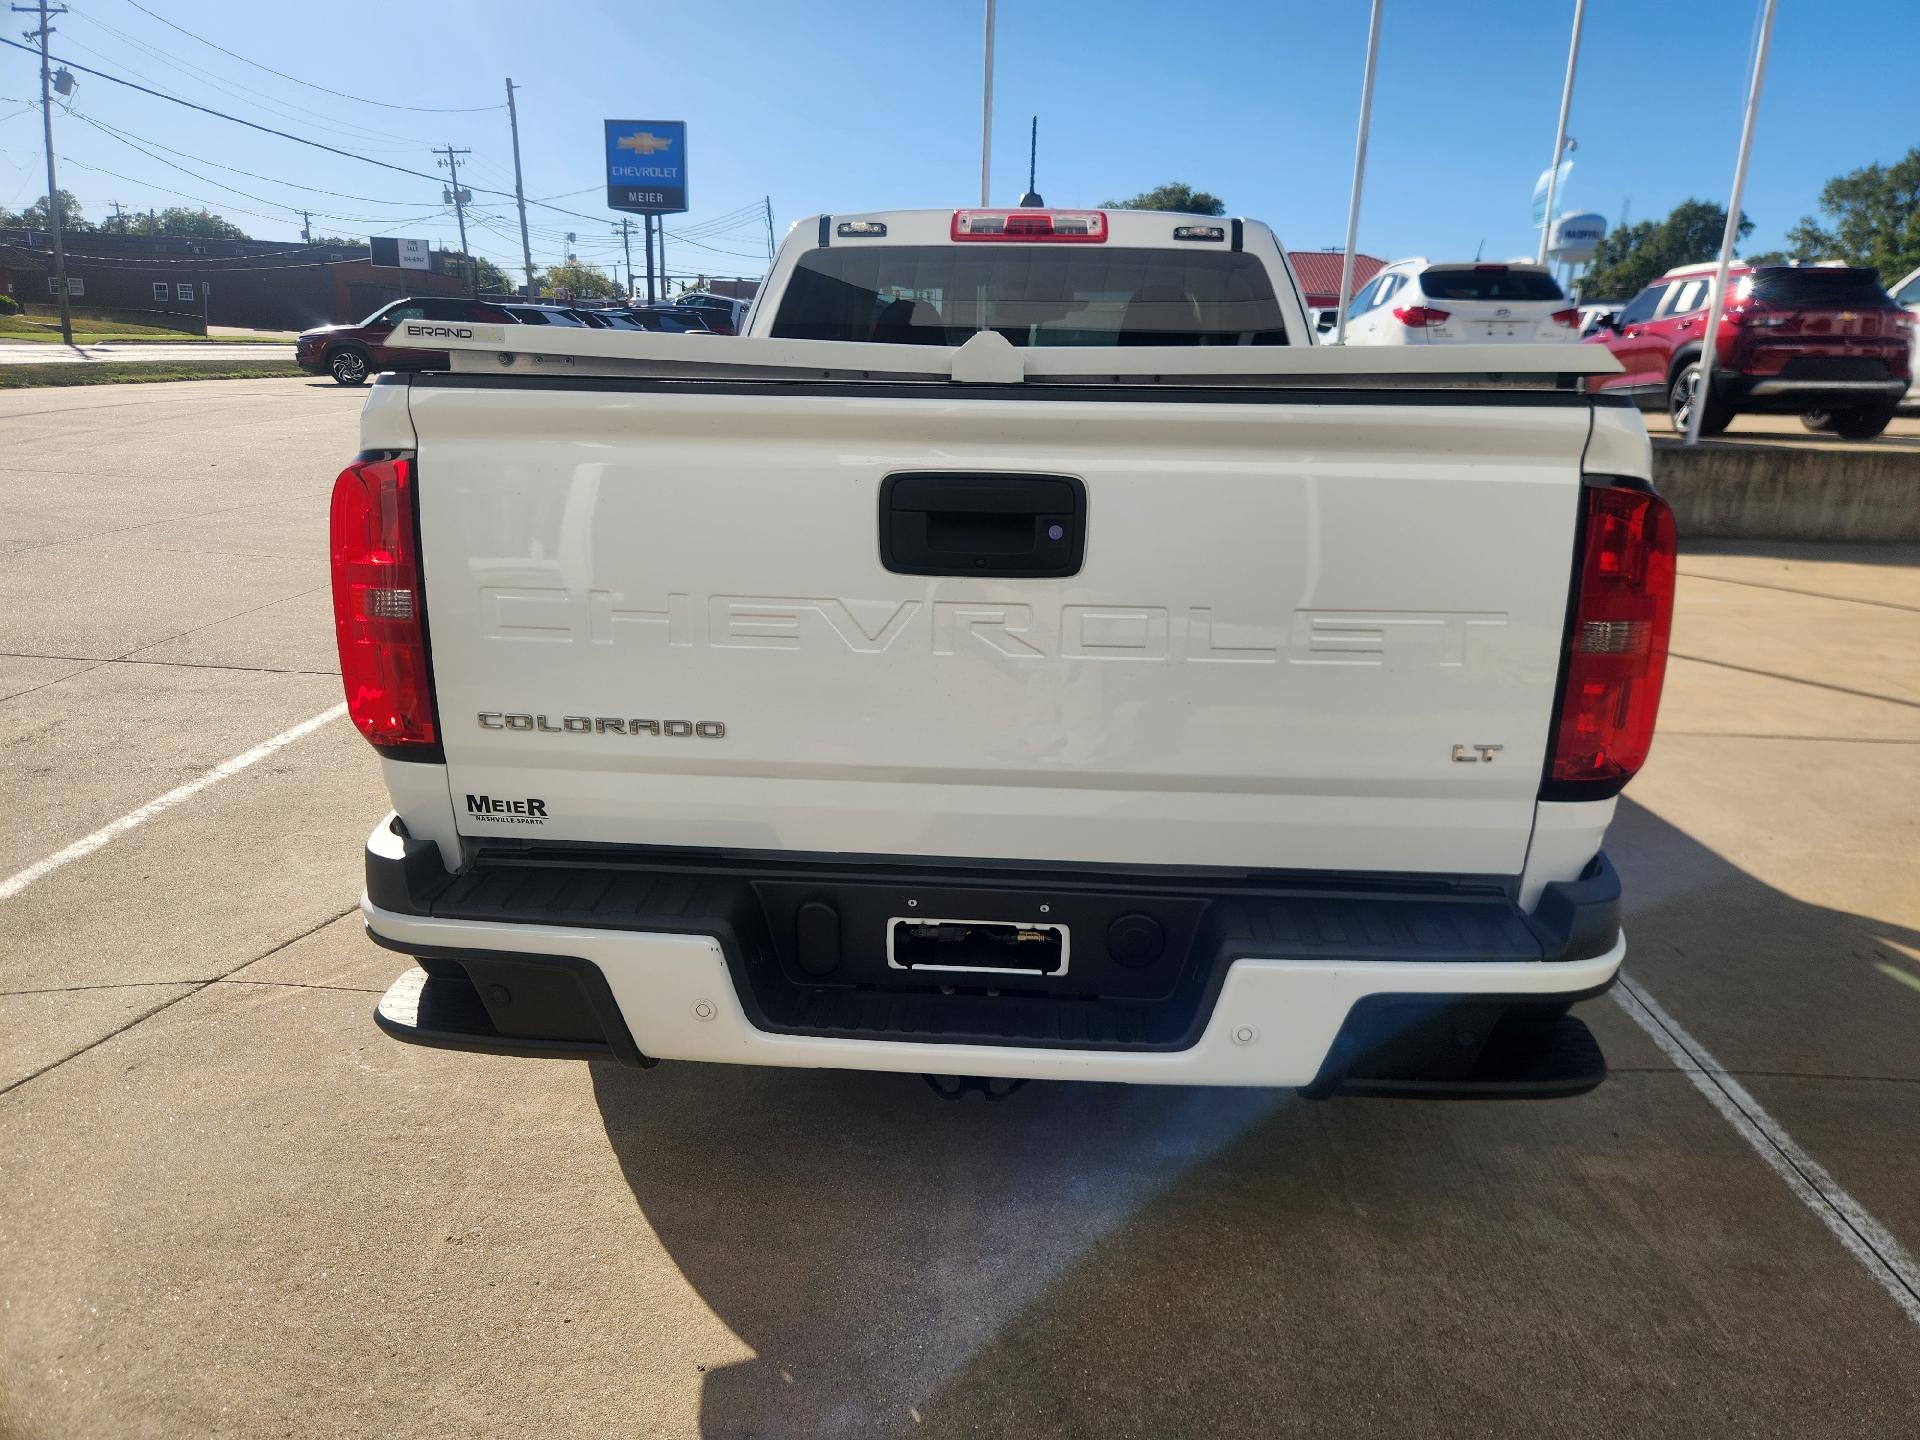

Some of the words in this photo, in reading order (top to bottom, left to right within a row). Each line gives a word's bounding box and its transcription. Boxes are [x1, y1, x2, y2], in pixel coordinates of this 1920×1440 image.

[612, 166, 678, 178] CHEVROLET
[629, 192, 664, 203] MEIER
[407, 325, 473, 339] BRAND
[478, 586, 1510, 667] CHEVROLET
[478, 711, 726, 738] COLORADO
[1451, 744, 1504, 762] LT
[466, 794, 548, 817] MEIER
